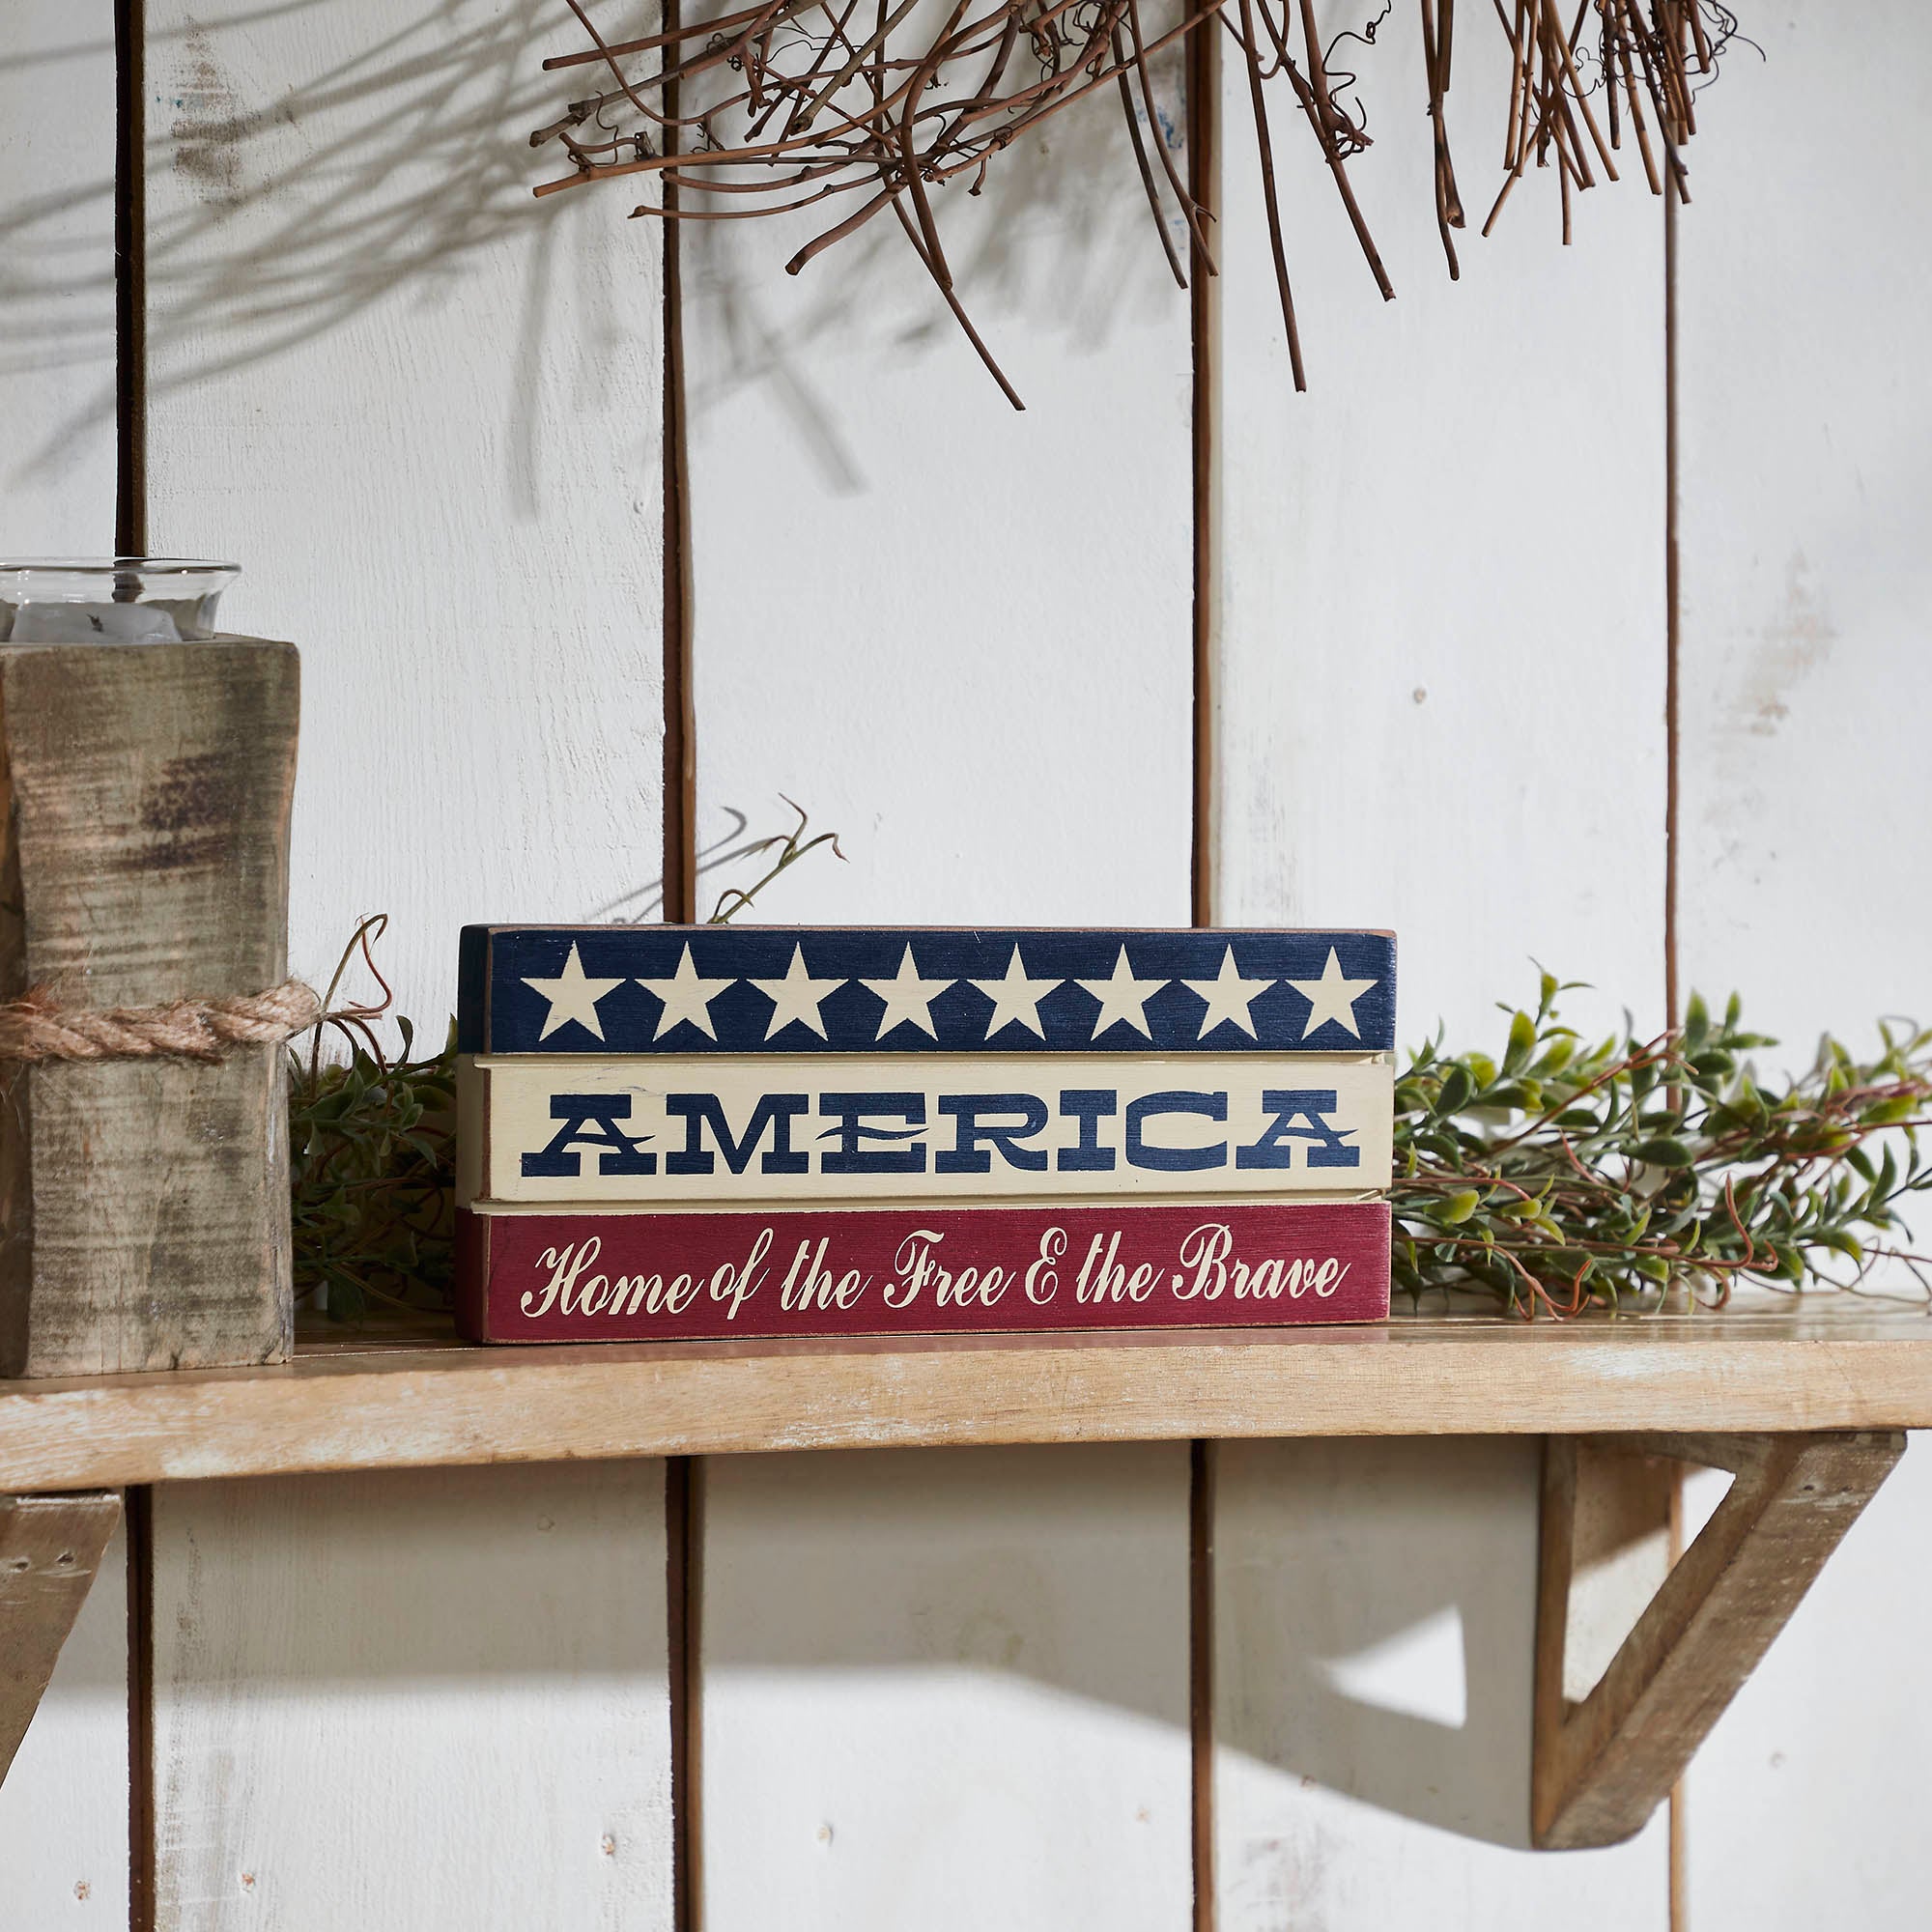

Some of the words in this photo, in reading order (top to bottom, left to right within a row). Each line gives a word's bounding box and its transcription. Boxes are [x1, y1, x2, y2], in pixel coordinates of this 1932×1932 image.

[521, 1089, 1360, 1178] AMERICA
[521, 1236, 705, 1319] Home
[709, 1227, 775, 1321] of
[780, 1236, 874, 1311] the
[883, 1229, 1017, 1309] Free
[1075, 1230, 1166, 1304] the
[1170, 1223, 1352, 1300] Brave
